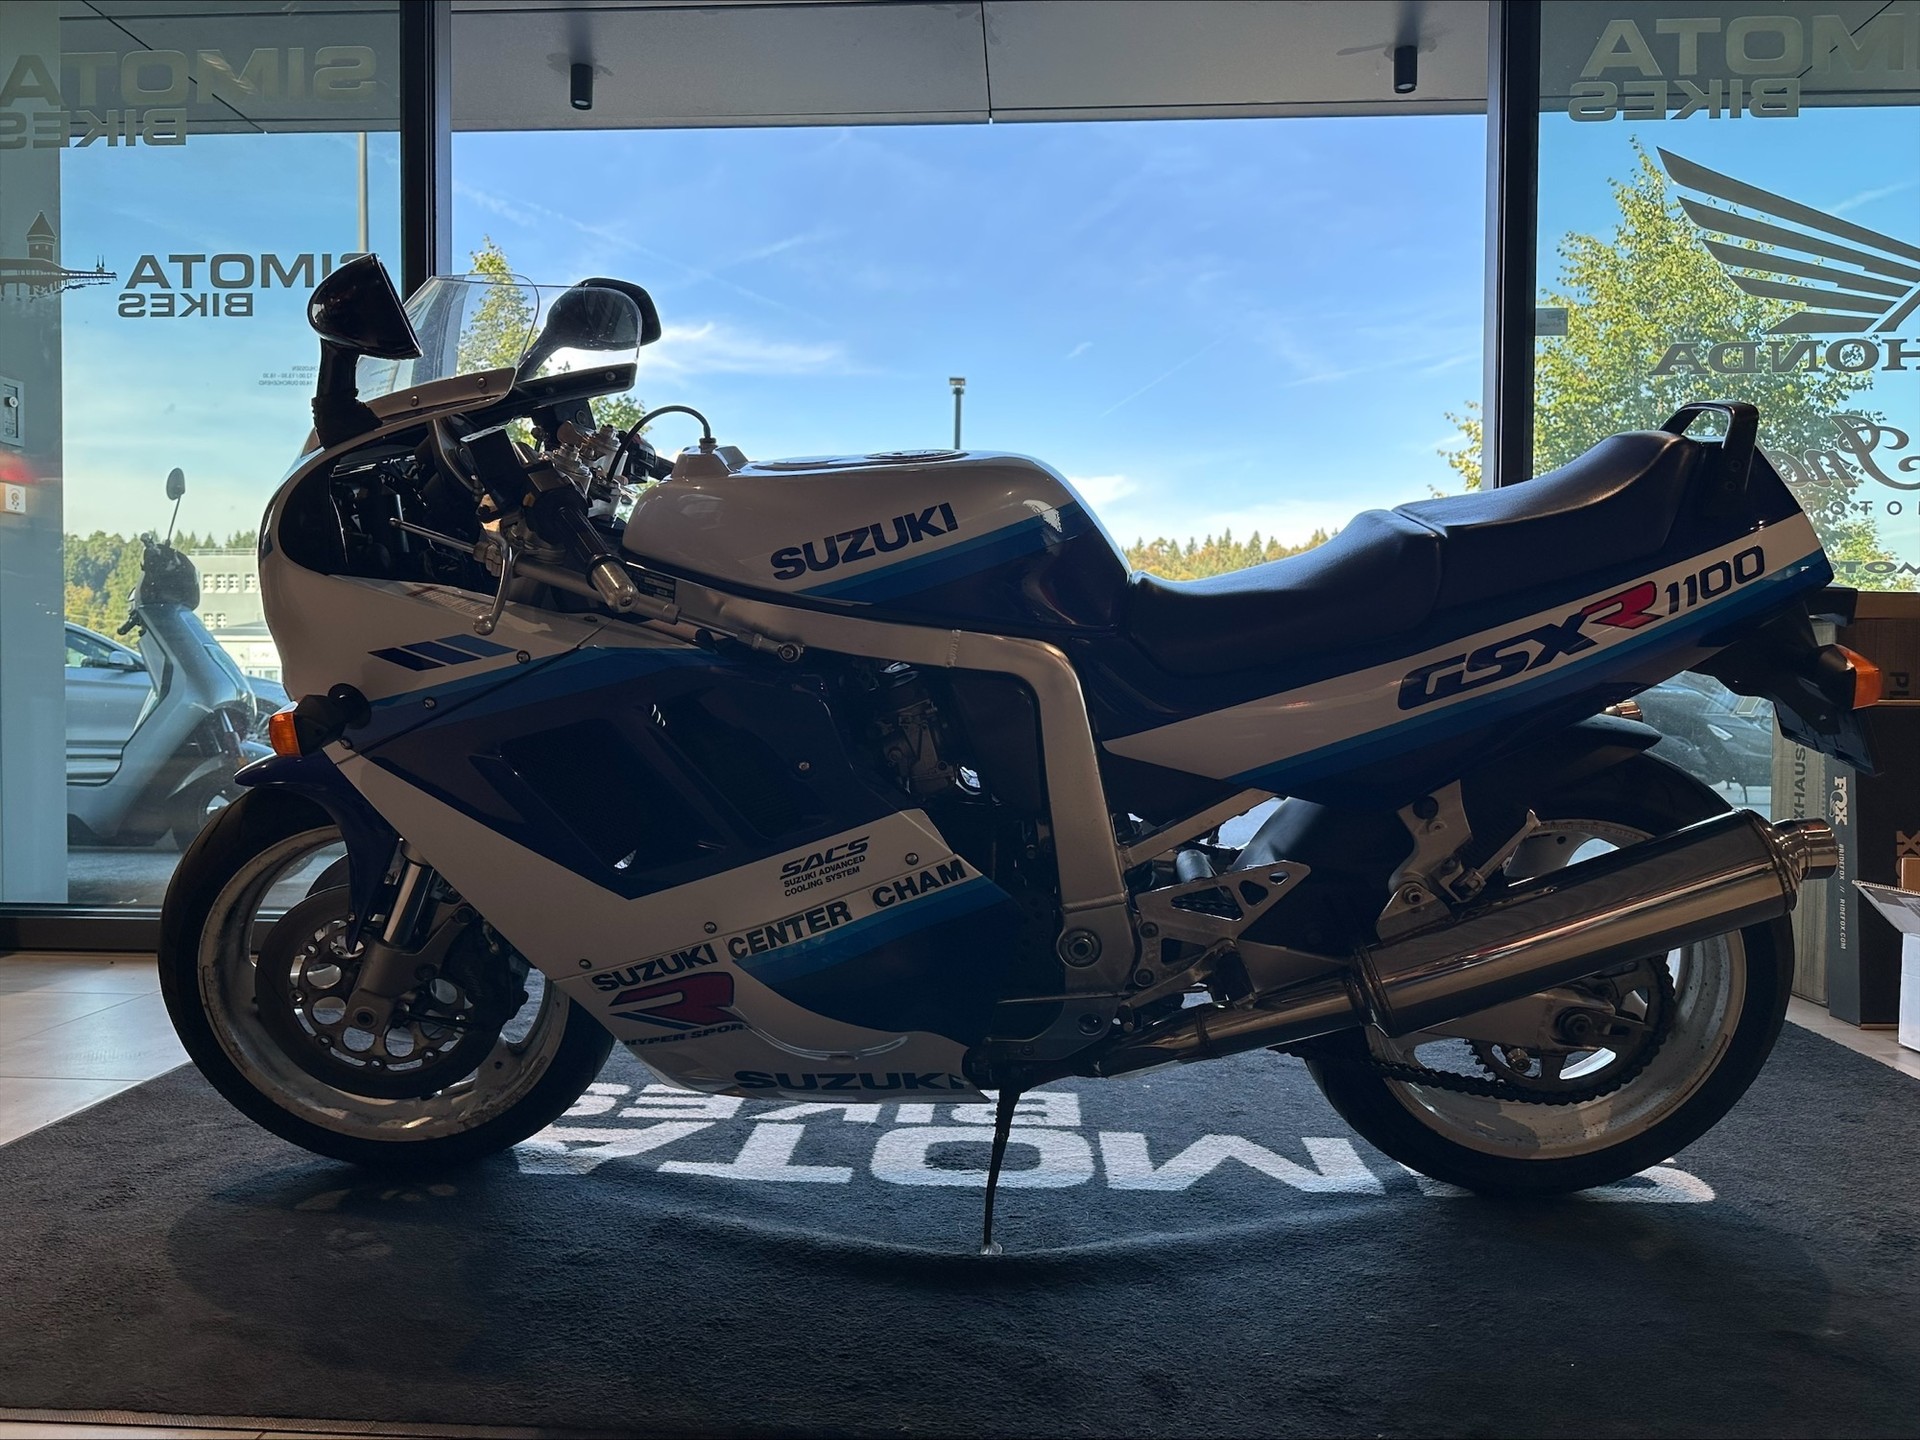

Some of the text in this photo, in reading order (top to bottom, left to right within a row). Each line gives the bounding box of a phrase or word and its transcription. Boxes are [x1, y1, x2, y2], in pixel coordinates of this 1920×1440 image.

[770, 502, 958, 580] SUZUKI
[1665, 545, 1765, 615] 1100
[1794, 742, 1806, 819] XHAUS
[1829, 776, 1848, 826] FOX
[780, 836, 870, 880] SACS
[784, 855, 866, 887] SUZUKI ADVANCED
[784, 866, 860, 897] COOLING SYSTEM
[591, 859, 967, 991] SUZUKI CENTER CHAM
[624, 1023, 750, 1046] HYPER SPOR
